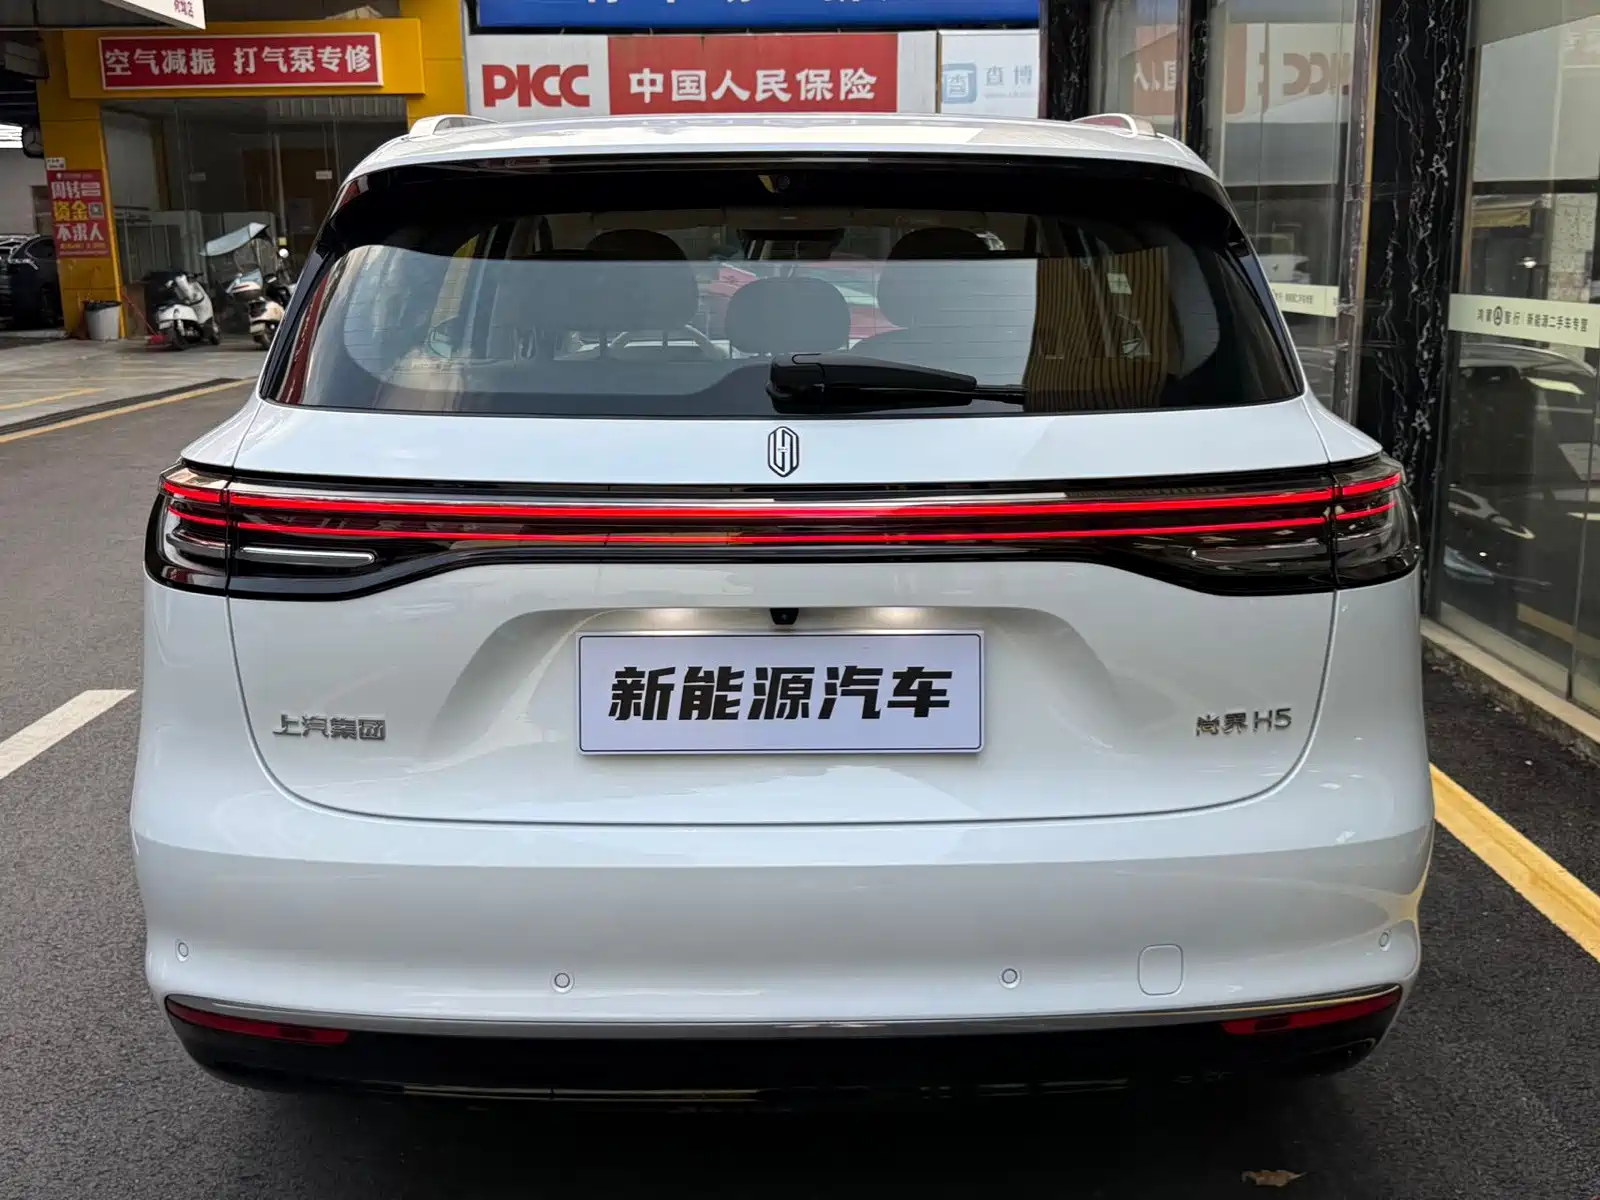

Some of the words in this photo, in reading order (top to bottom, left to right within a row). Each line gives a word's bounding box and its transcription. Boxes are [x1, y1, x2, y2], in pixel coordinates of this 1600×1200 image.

[105, 48, 216, 76] 空气减振
[233, 45, 371, 75] 打气泵专修
[482, 64, 590, 107] PICC
[628, 67, 877, 103] 中国人民保险
[54, 200, 89, 221] 资金
[56, 222, 105, 242] 不求人
[608, 666, 953, 720] 新能源汽车
[272, 714, 386, 741] 上汽集团
[1196, 712, 1248, 737] 尚界
[1253, 708, 1292, 732] H5
